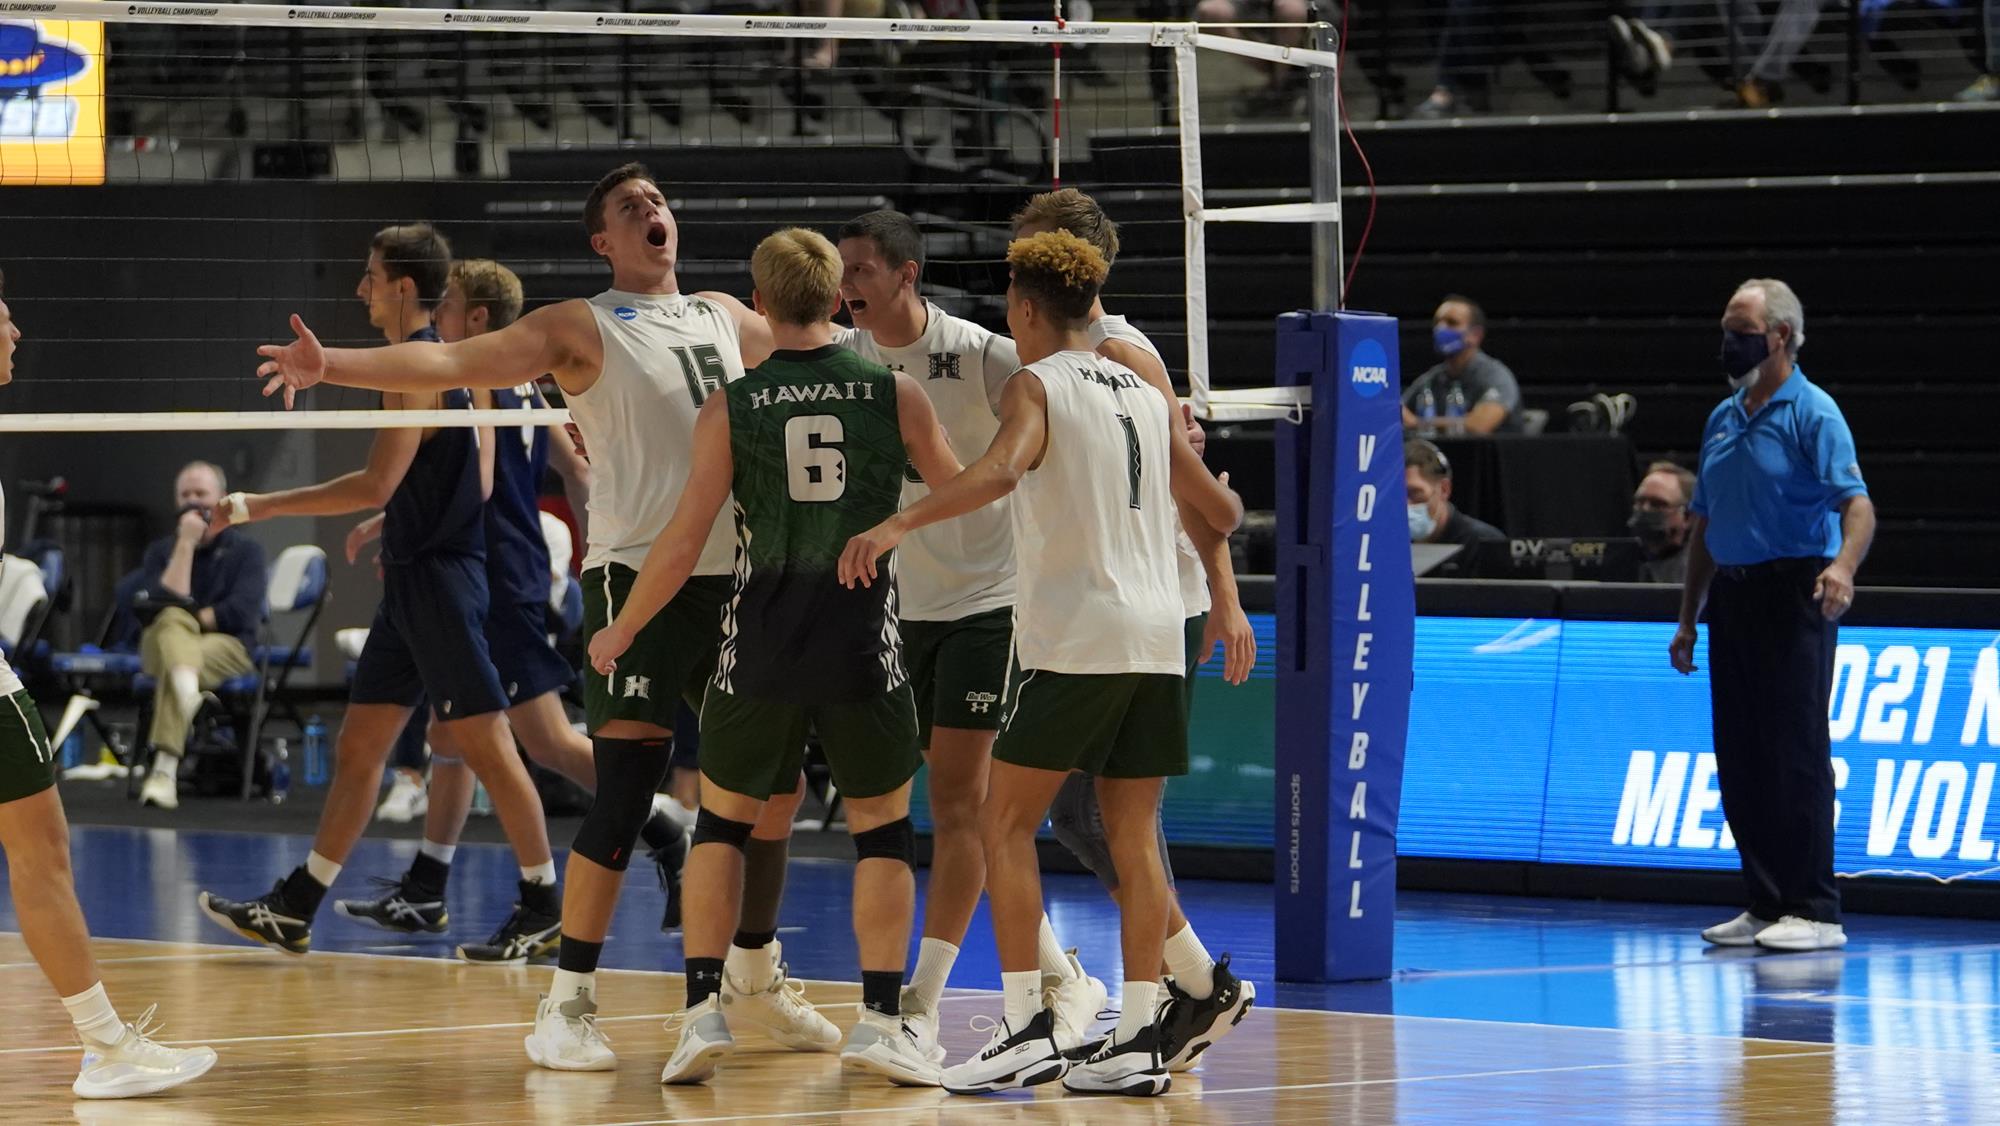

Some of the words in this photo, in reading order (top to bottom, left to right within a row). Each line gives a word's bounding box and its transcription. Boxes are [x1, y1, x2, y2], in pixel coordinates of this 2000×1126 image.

[9, 3, 57, 12] CHAMPIONSHIP
[137, 6, 171, 15] VOLLEYBALL
[172, 7, 219, 16] CHAMPIONSHIP
[297, 11, 330, 19] VOLLEYBALL
[331, 11, 377, 20] CHAMPIONSHIP
[453, 14, 485, 23] VOLLEYBALL
[486, 15, 531, 23] CHAMPIONSHIP
[604, 18, 636, 26] VOLLEYBALL
[667, 343, 729, 408] 15
[750, 381, 875, 410] HAWAI'I
[1352, 366, 1387, 384] NCAA
[785, 414, 846, 502] 6
[1115, 413, 1141, 510] 1
[1348, 434, 1377, 919] VOLLEYBALL
[1828, 644, 1950, 744] 021
[1290, 774, 1302, 827] sports
[1289, 828, 1300, 895] imports
